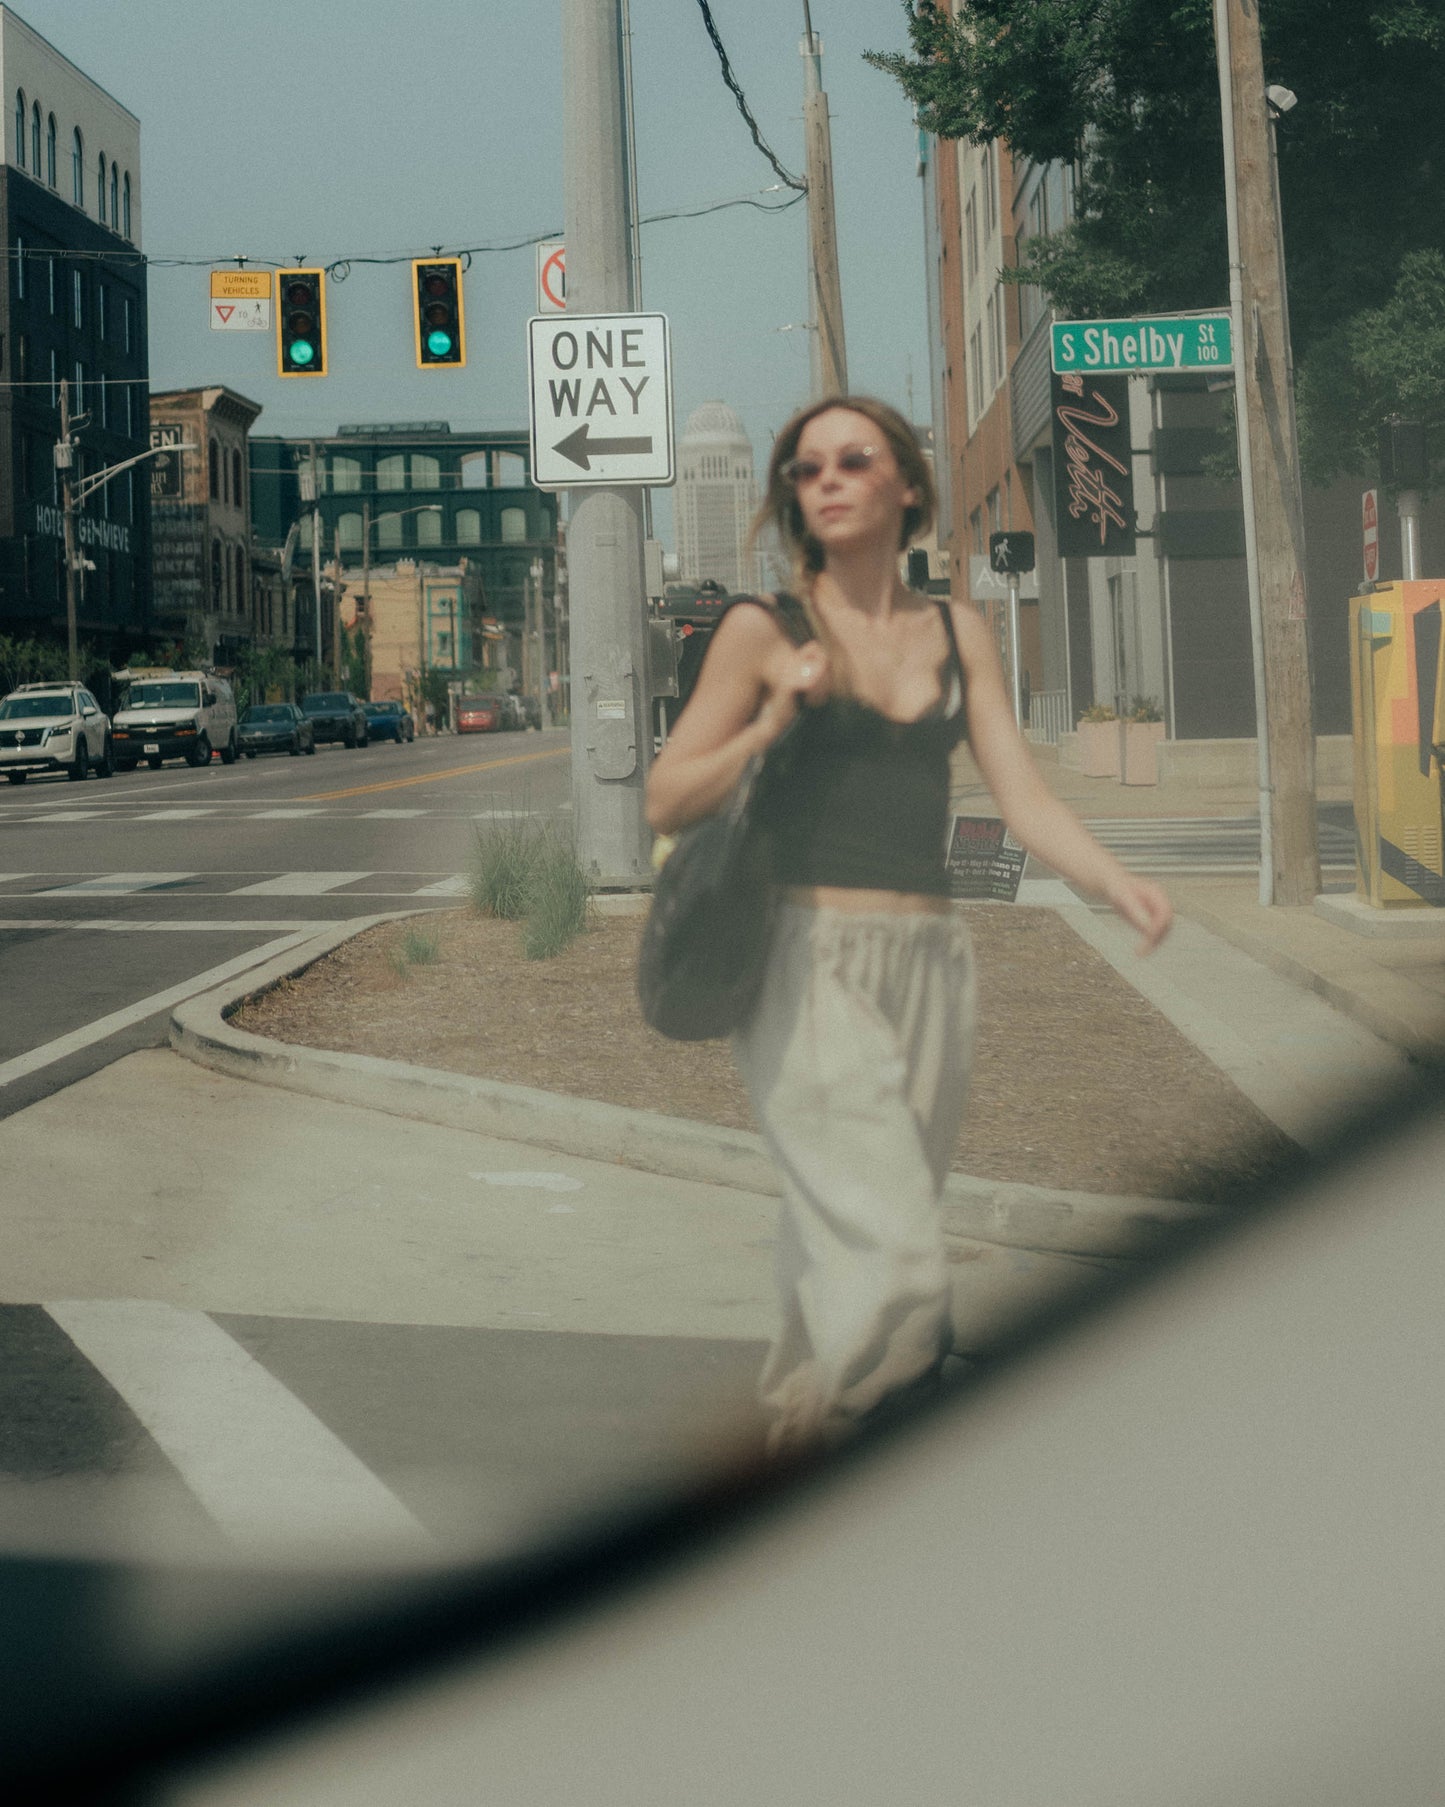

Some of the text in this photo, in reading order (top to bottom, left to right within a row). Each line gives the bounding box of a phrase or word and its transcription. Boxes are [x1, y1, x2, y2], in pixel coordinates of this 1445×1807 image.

[224, 276, 259, 284] TURNING
[222, 286, 260, 295] VEHICLES
[238, 311, 248, 319] TO
[552, 329, 646, 370] ONE
[1061, 324, 1215, 368] S Shelby St
[1197, 345, 1219, 361] 100
[548, 376, 651, 418] WAY
